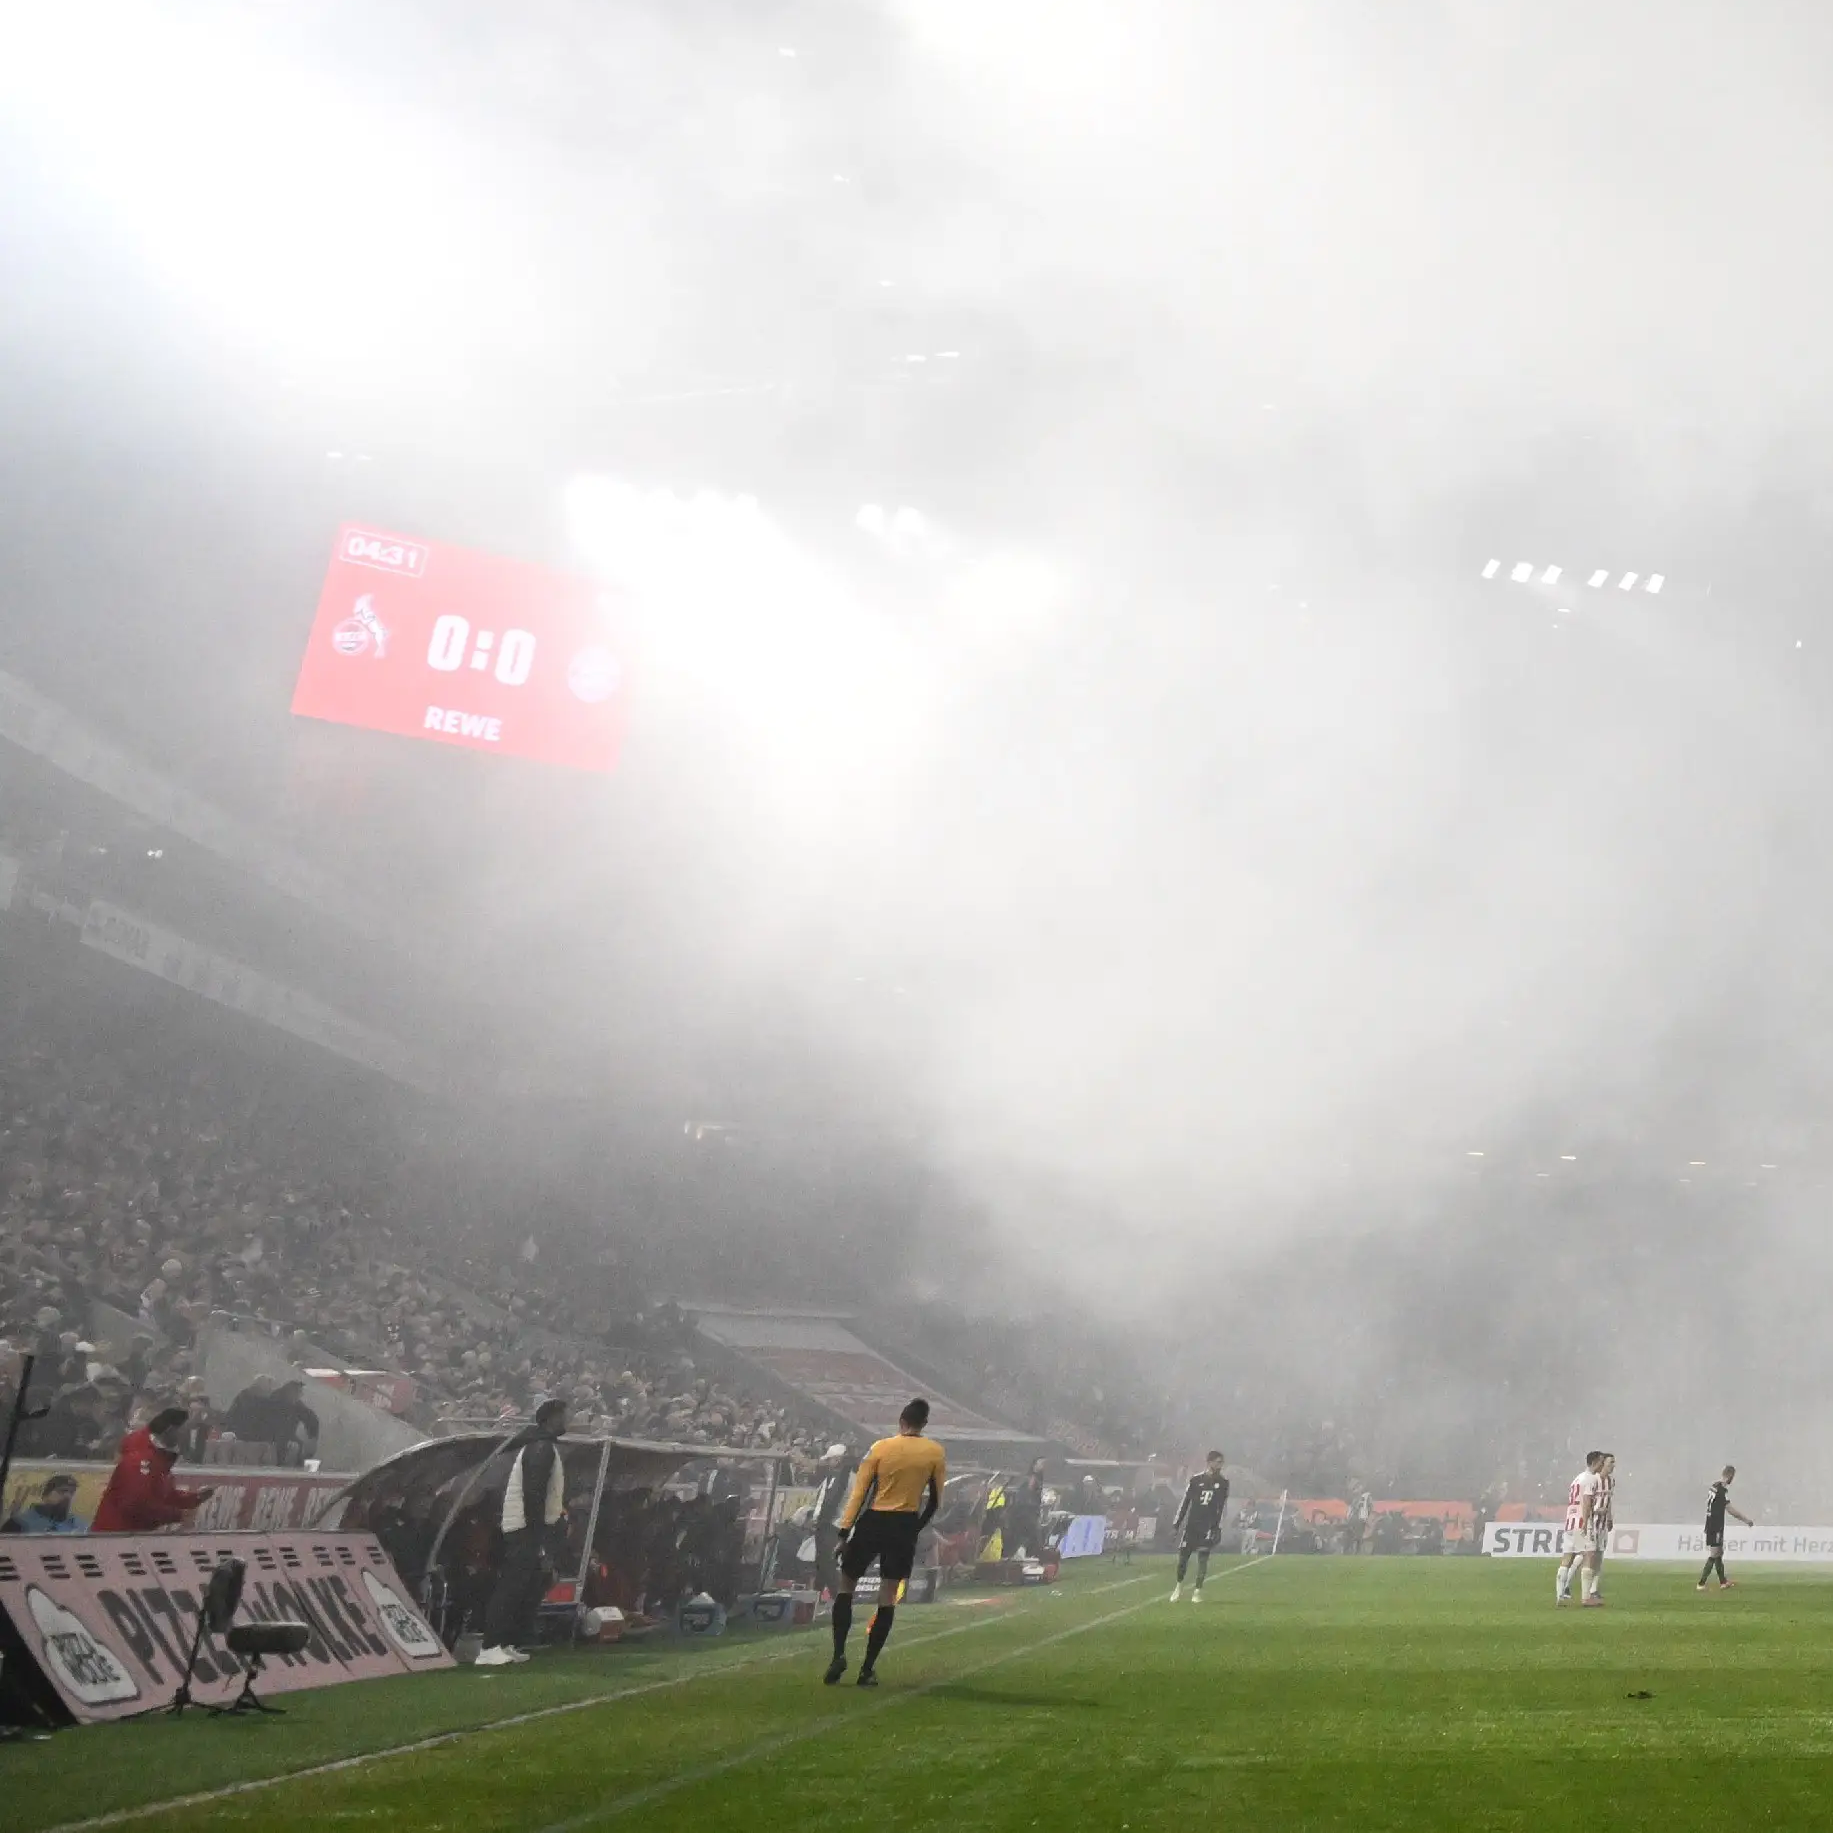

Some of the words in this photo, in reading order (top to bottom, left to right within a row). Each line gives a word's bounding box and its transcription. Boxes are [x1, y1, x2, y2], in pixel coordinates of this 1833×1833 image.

[347, 535, 419, 570] 04:31
[427, 614, 537, 686] 0:0
[424, 706, 503, 742] REWE
[1678, 1534, 1748, 1552] Häer
[1754, 1536, 1787, 1553] mit
